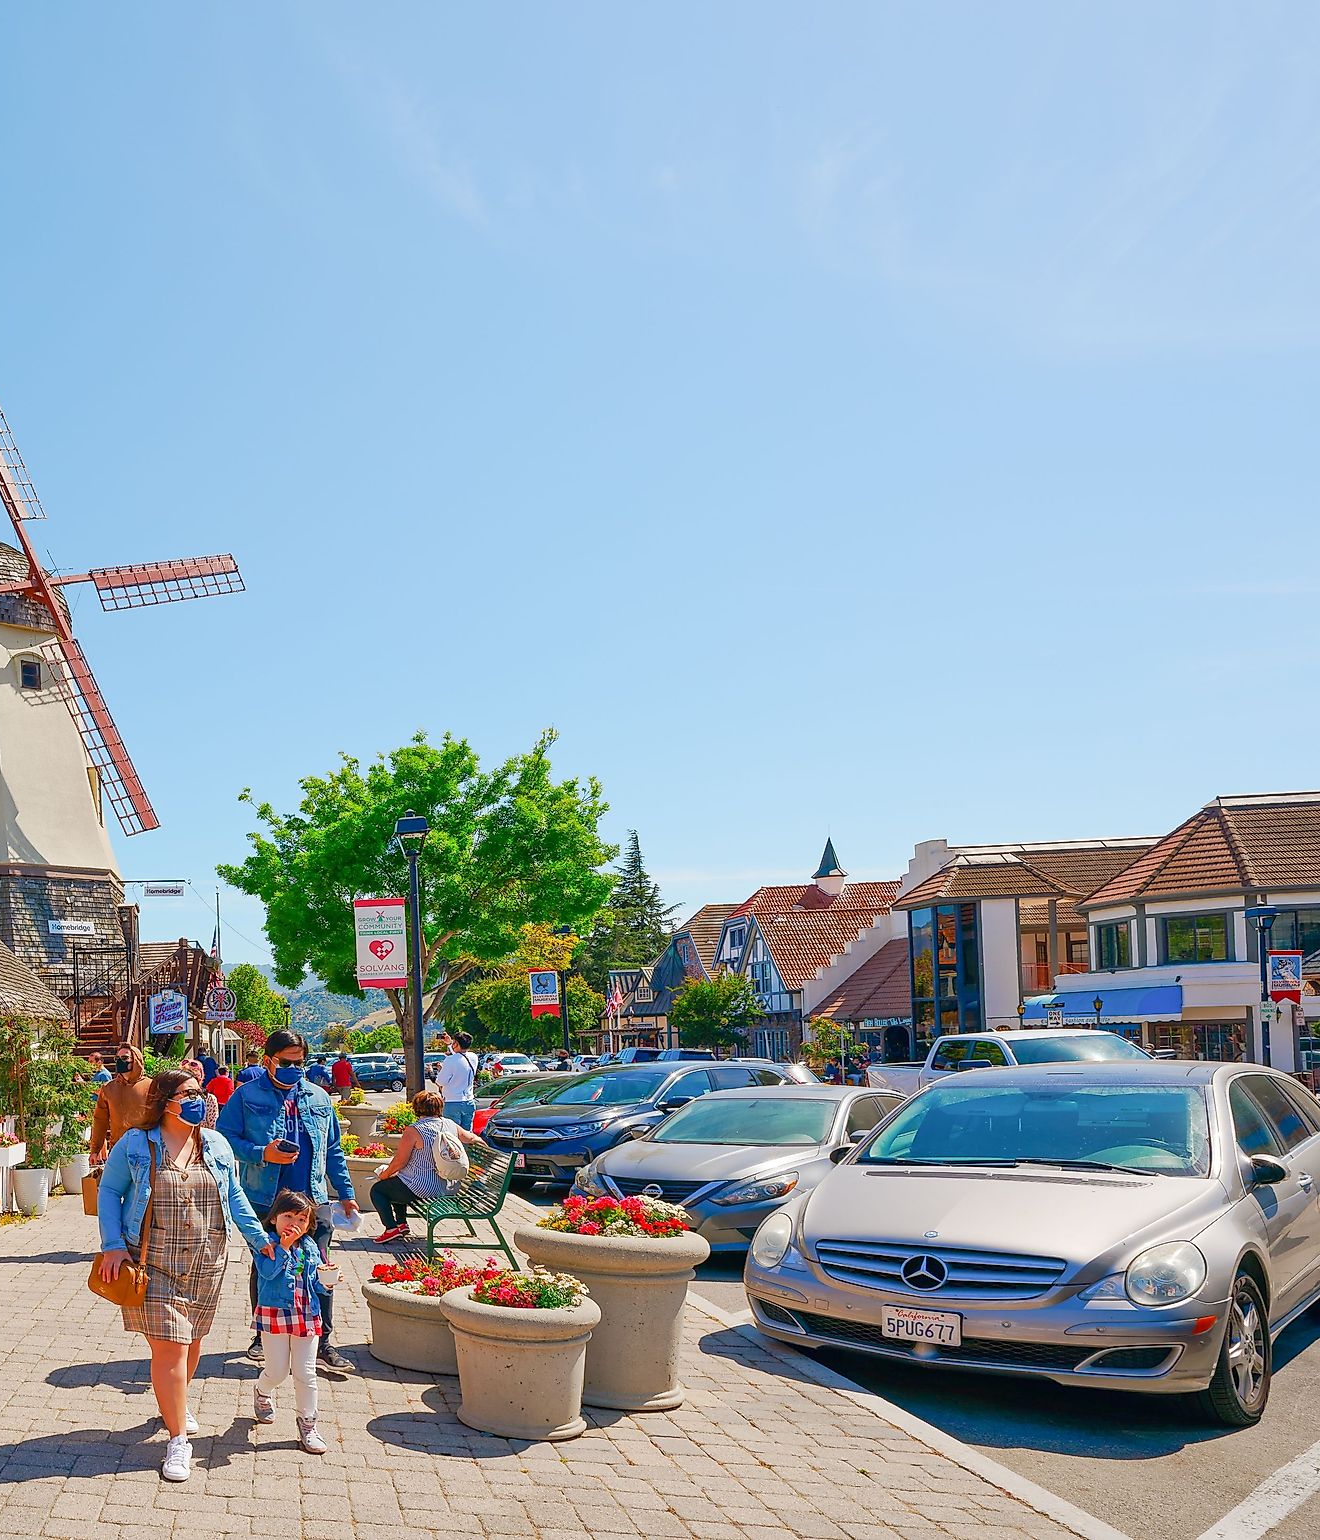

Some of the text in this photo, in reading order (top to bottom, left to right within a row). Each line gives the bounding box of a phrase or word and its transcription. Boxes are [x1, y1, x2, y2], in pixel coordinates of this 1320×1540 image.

[146, 887, 181, 895] Homebridge
[51, 923, 91, 933] Homebridge
[360, 964, 405, 972] SOLVANG
[155, 1002, 182, 1014] Tower
[155, 1011, 183, 1024] Pizza
[897, 1309, 940, 1321] California
[887, 1318, 955, 1341] 5PUG677
